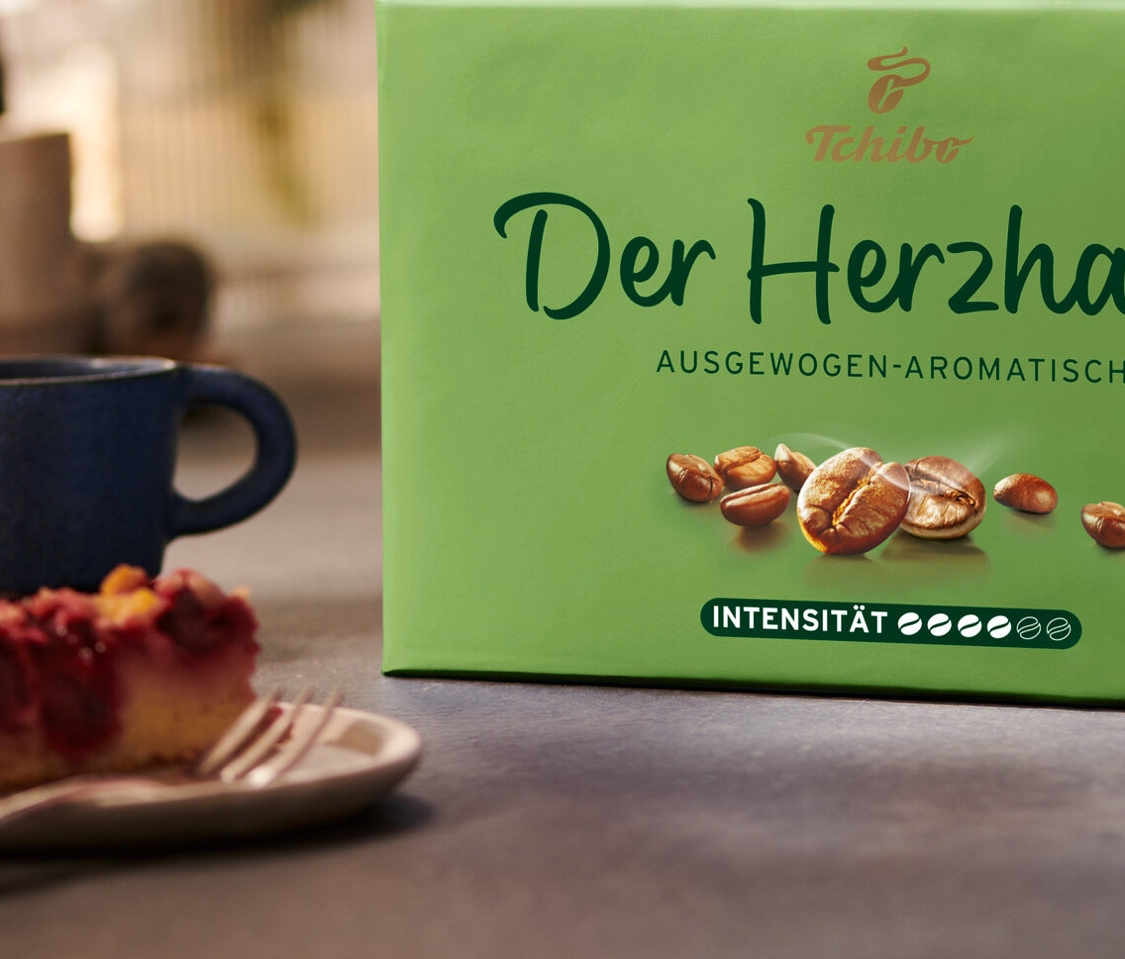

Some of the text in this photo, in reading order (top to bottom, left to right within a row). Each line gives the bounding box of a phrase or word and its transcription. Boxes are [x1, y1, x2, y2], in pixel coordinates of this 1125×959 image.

[804, 124, 974, 164] Tchibo
[493, 191, 716, 320] Der
[712, 604, 889, 634] INTENSITÄT
